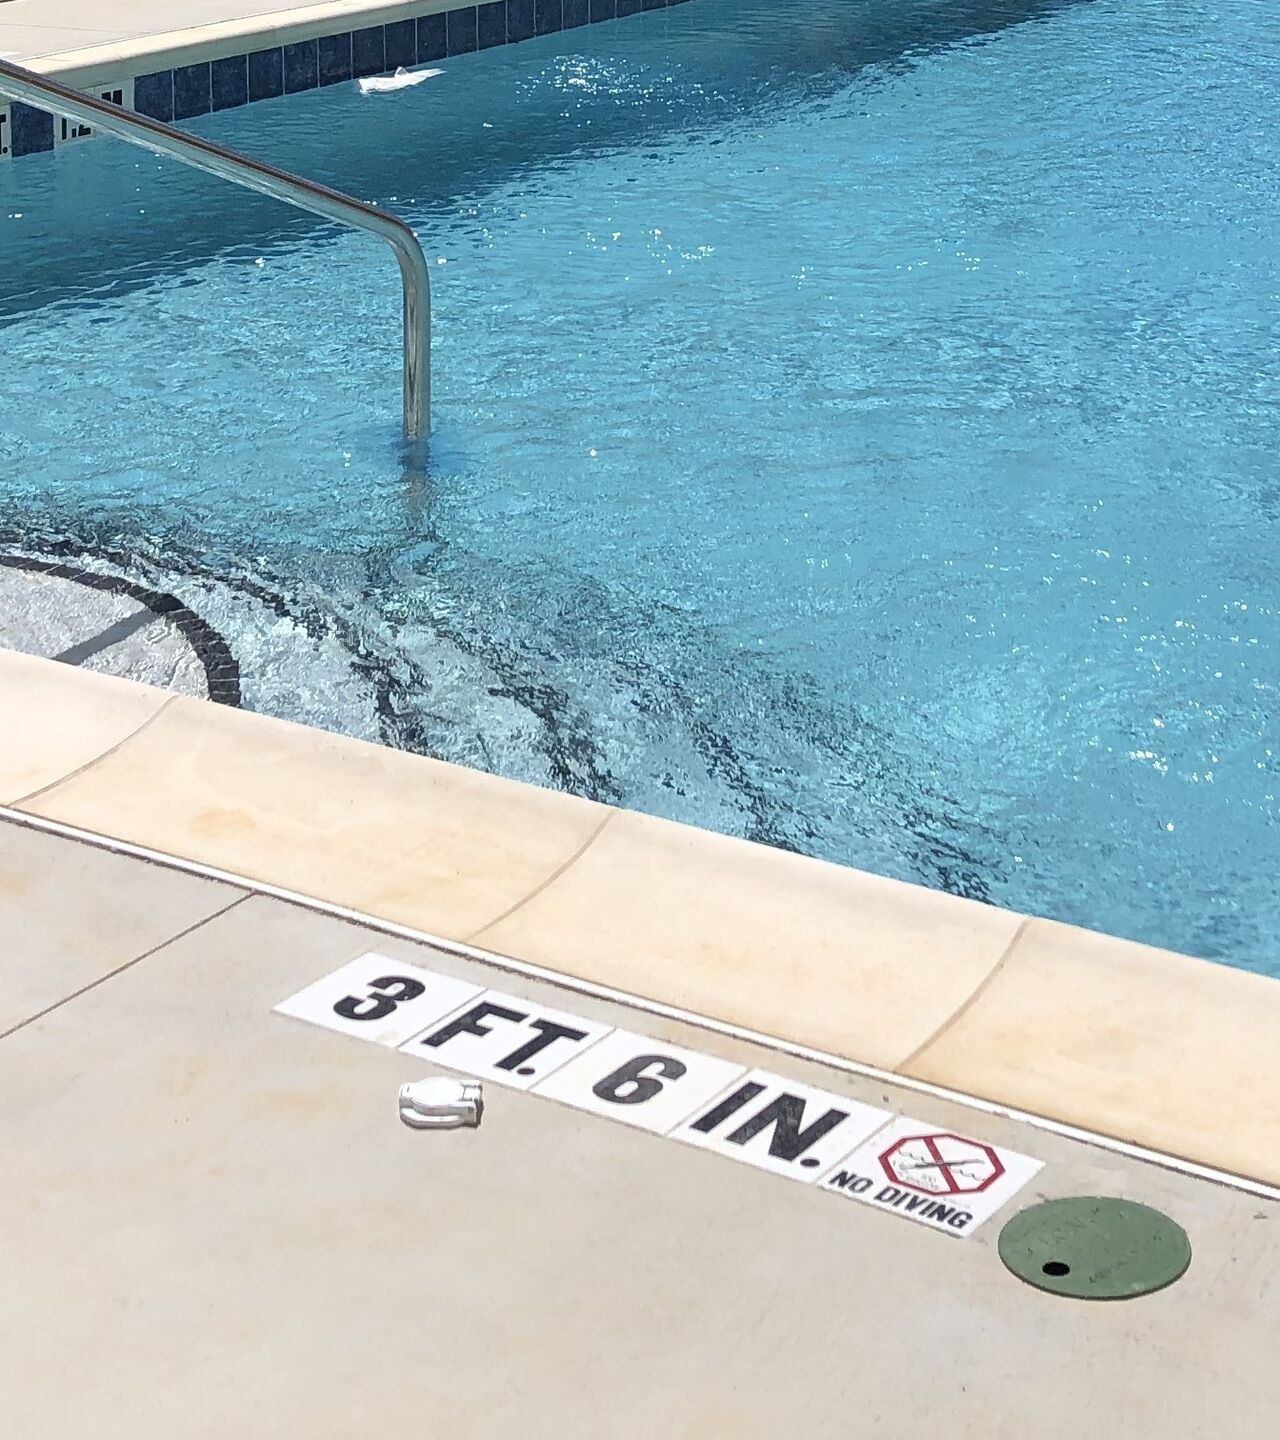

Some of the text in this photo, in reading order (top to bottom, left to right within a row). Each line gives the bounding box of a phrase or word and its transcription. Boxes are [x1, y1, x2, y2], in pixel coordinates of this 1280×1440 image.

[332, 973, 851, 1169] 3 FT. 6 IN.
[828, 1168, 974, 1230] NO DIVING
